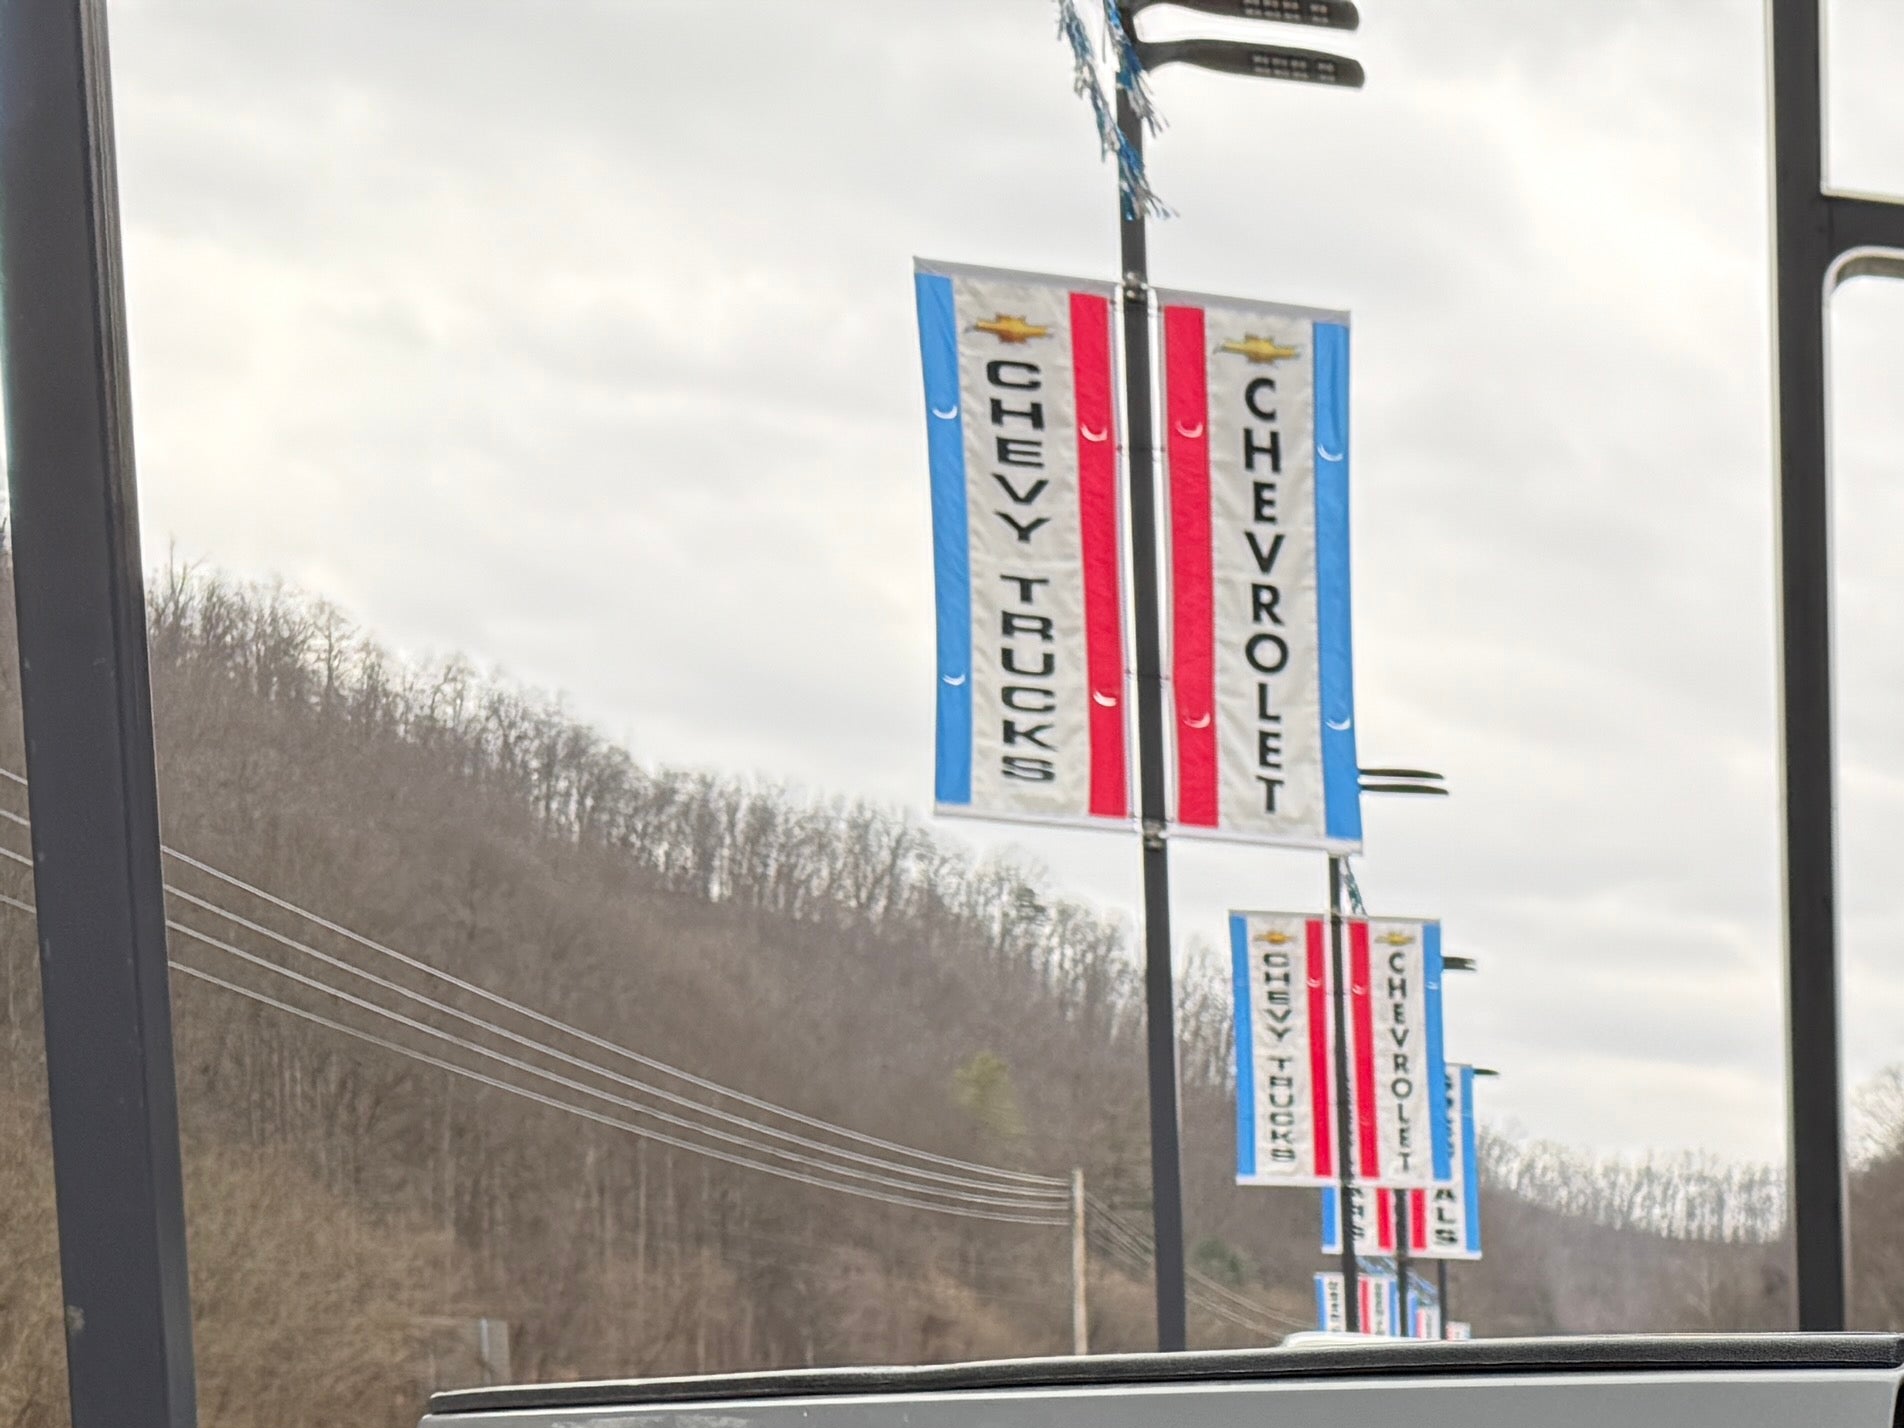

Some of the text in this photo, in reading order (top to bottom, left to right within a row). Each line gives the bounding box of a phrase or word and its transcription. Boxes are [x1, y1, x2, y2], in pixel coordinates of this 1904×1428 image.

[986, 360, 1057, 784] CHEVY TRUCKS
[1242, 376, 1289, 815] CHEVROLET
[1263, 953, 1296, 1163] CHEVY TRUCKS
[1387, 952, 1413, 1171] CHEVROLET
